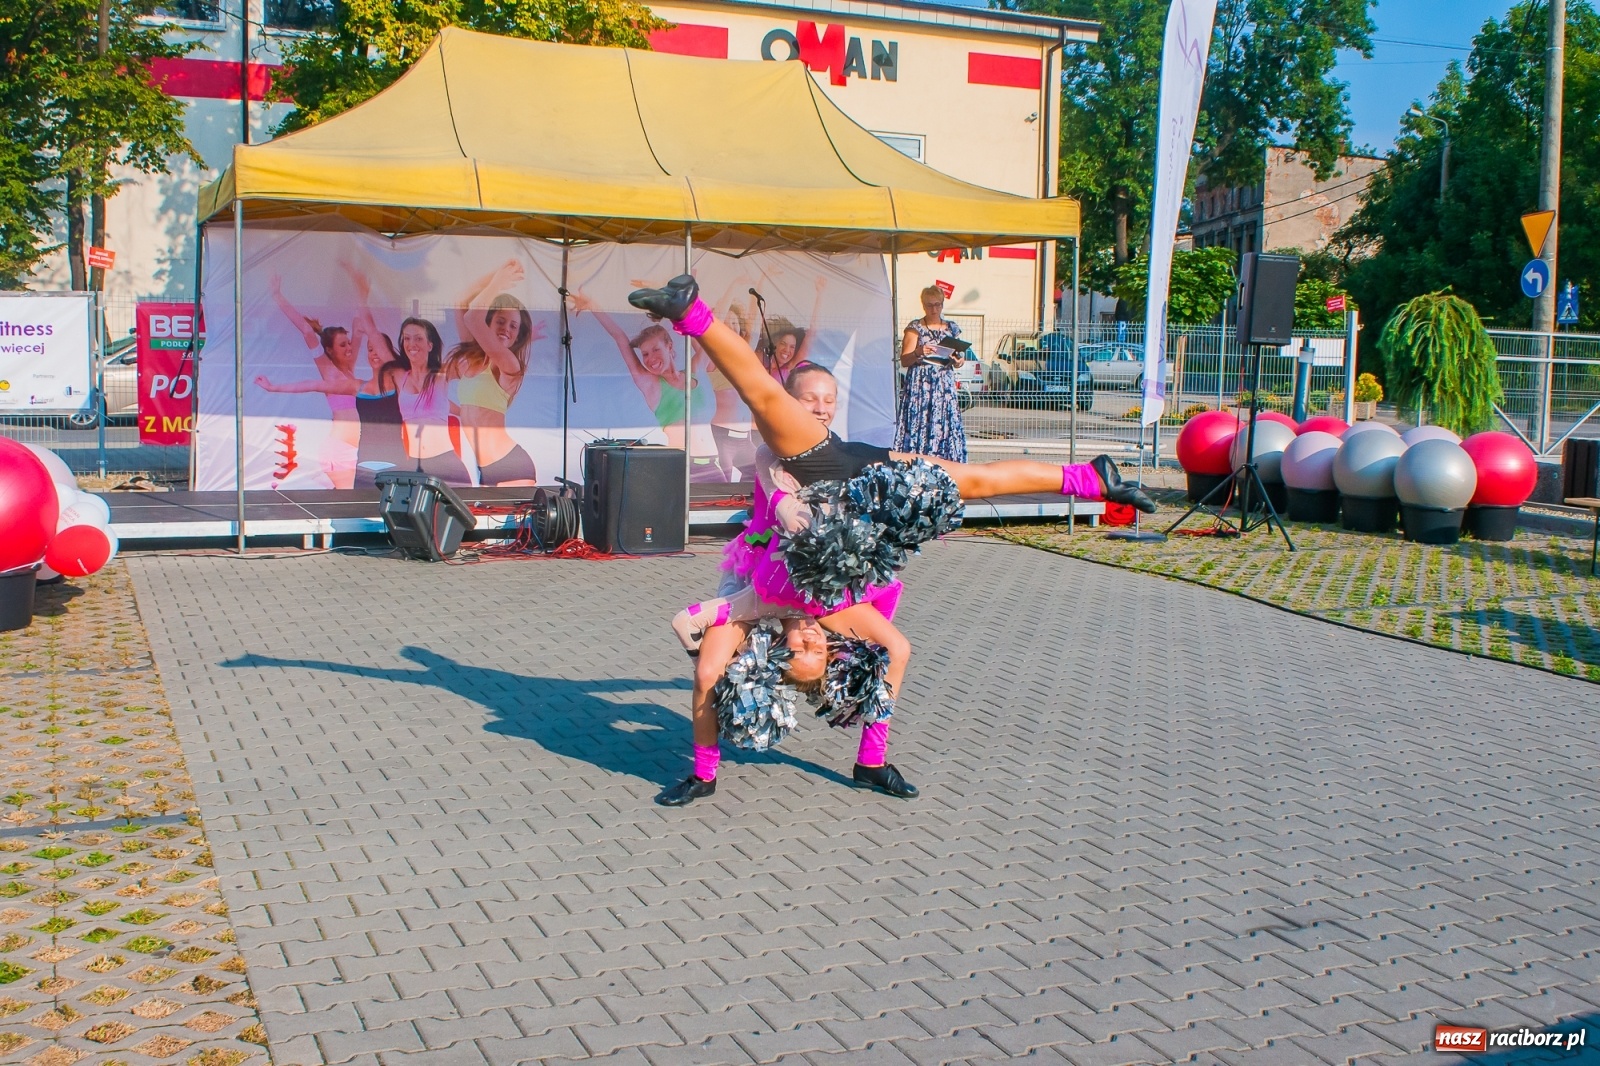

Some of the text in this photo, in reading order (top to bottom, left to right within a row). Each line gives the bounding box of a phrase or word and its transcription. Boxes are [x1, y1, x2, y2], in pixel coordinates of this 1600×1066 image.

[761, 20, 898, 86] OMAN
[1, 343, 45, 355] więcej
[144, 415, 157, 433] Z
